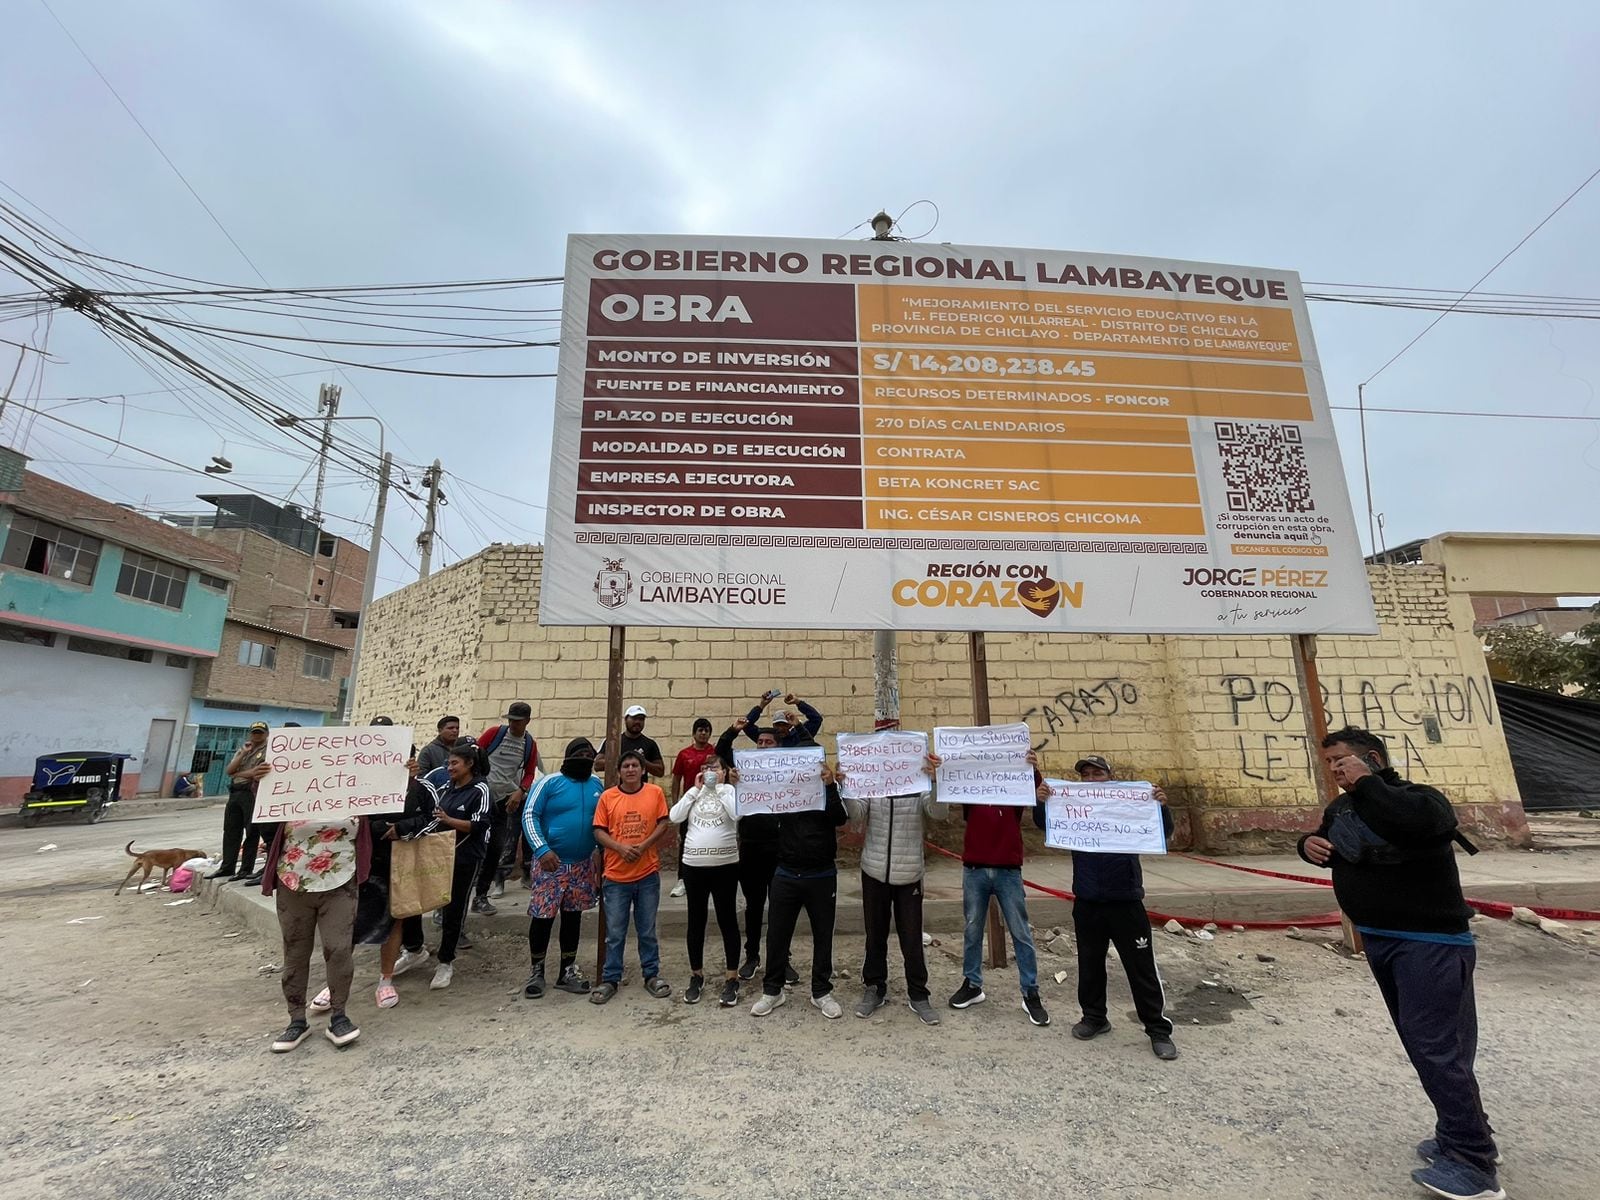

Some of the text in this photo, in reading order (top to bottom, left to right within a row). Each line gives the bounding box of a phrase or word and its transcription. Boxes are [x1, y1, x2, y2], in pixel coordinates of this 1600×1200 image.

[593, 249, 1289, 301] GOBIERNO REGIONAL LAMBAYEQUE
[600, 293, 753, 323] OBRA
[1034, 303, 1063, 314] DEL
[1066, 304, 1132, 318] SERVICIO
[1136, 309, 1215, 323] EDUCATIVO
[1218, 314, 1237, 324] EN
[1241, 316, 1258, 326] LA
[903, 311, 925, 321] I.E.
[930, 312, 1005, 324] FEDERICO
[1009, 315, 1089, 328] VILLARREAL
[1100, 319, 1165, 333] DISTRITO
[1168, 324, 1188, 334] DE
[1191, 326, 1259, 339] CHICLAYO
[871, 323, 956, 336] PROVINCIA
[960, 326, 981, 336] DE
[985, 327, 1060, 340] CHICLAYO
[1073, 331, 1190, 348] DEPARTAMENTO
[1194, 338, 1213, 348] DE
[598, 349, 831, 367] MONTO DE INVERSIÓN
[874, 352, 1096, 376] S/ 14,208,238.45
[596, 379, 844, 396] FUENTE DE FINANCIAMIENTO
[875, 387, 961, 400] RECURSOS
[965, 389, 1092, 404] DETERMINADOS
[1105, 394, 1169, 406] FONCOR
[594, 410, 794, 426] PLAZO DE EJECUCIÓN
[875, 416, 1066, 433] 270 DÍAS CALENDARIOS
[592, 441, 846, 458] MODALIDAD DE EJECUCIÓN
[877, 446, 967, 460] CONTRATA
[590, 471, 795, 487] EMPRESA EJECUTORA
[878, 477, 1040, 491] BETA KONCRET SAC
[588, 503, 786, 519] INSPECTOR DE OBRA
[879, 507, 1142, 525] ING. CÉSAR CISNEROS CHICOMA
[1232, 513, 1276, 522] observas
[1317, 515, 1329, 523] de
[1216, 523, 1271, 532] corrupción
[1233, 531, 1281, 540] denuncia
[927, 560, 1048, 579] REGIÓN CON
[1182, 565, 1329, 587] JORGE PÉREZ
[641, 571, 786, 586] GOBIERNO REGIONAL
[640, 586, 787, 605] LAMBAYEQUE
[1200, 590, 1318, 599] GOBERNADOR REGIONAL
[271, 733, 387, 753] QUEREMOS
[938, 733, 958, 748] NO
[962, 734, 979, 747] AL
[271, 752, 403, 773] QUE SE ROMPA
[736, 759, 751, 770] NO
[941, 752, 967, 762] DEL
[882, 759, 910, 772] QUE
[942, 768, 983, 783] LETICIA
[272, 781, 296, 795] EL
[1061, 786, 1074, 798] AL
[324, 799, 344, 810] SE
[348, 792, 404, 809] RESPETA
[738, 788, 801, 805] OBRAS NO SE
[1048, 819, 1153, 835] LAS OBRAS NO SE
[1053, 834, 1102, 848] VENDEN
